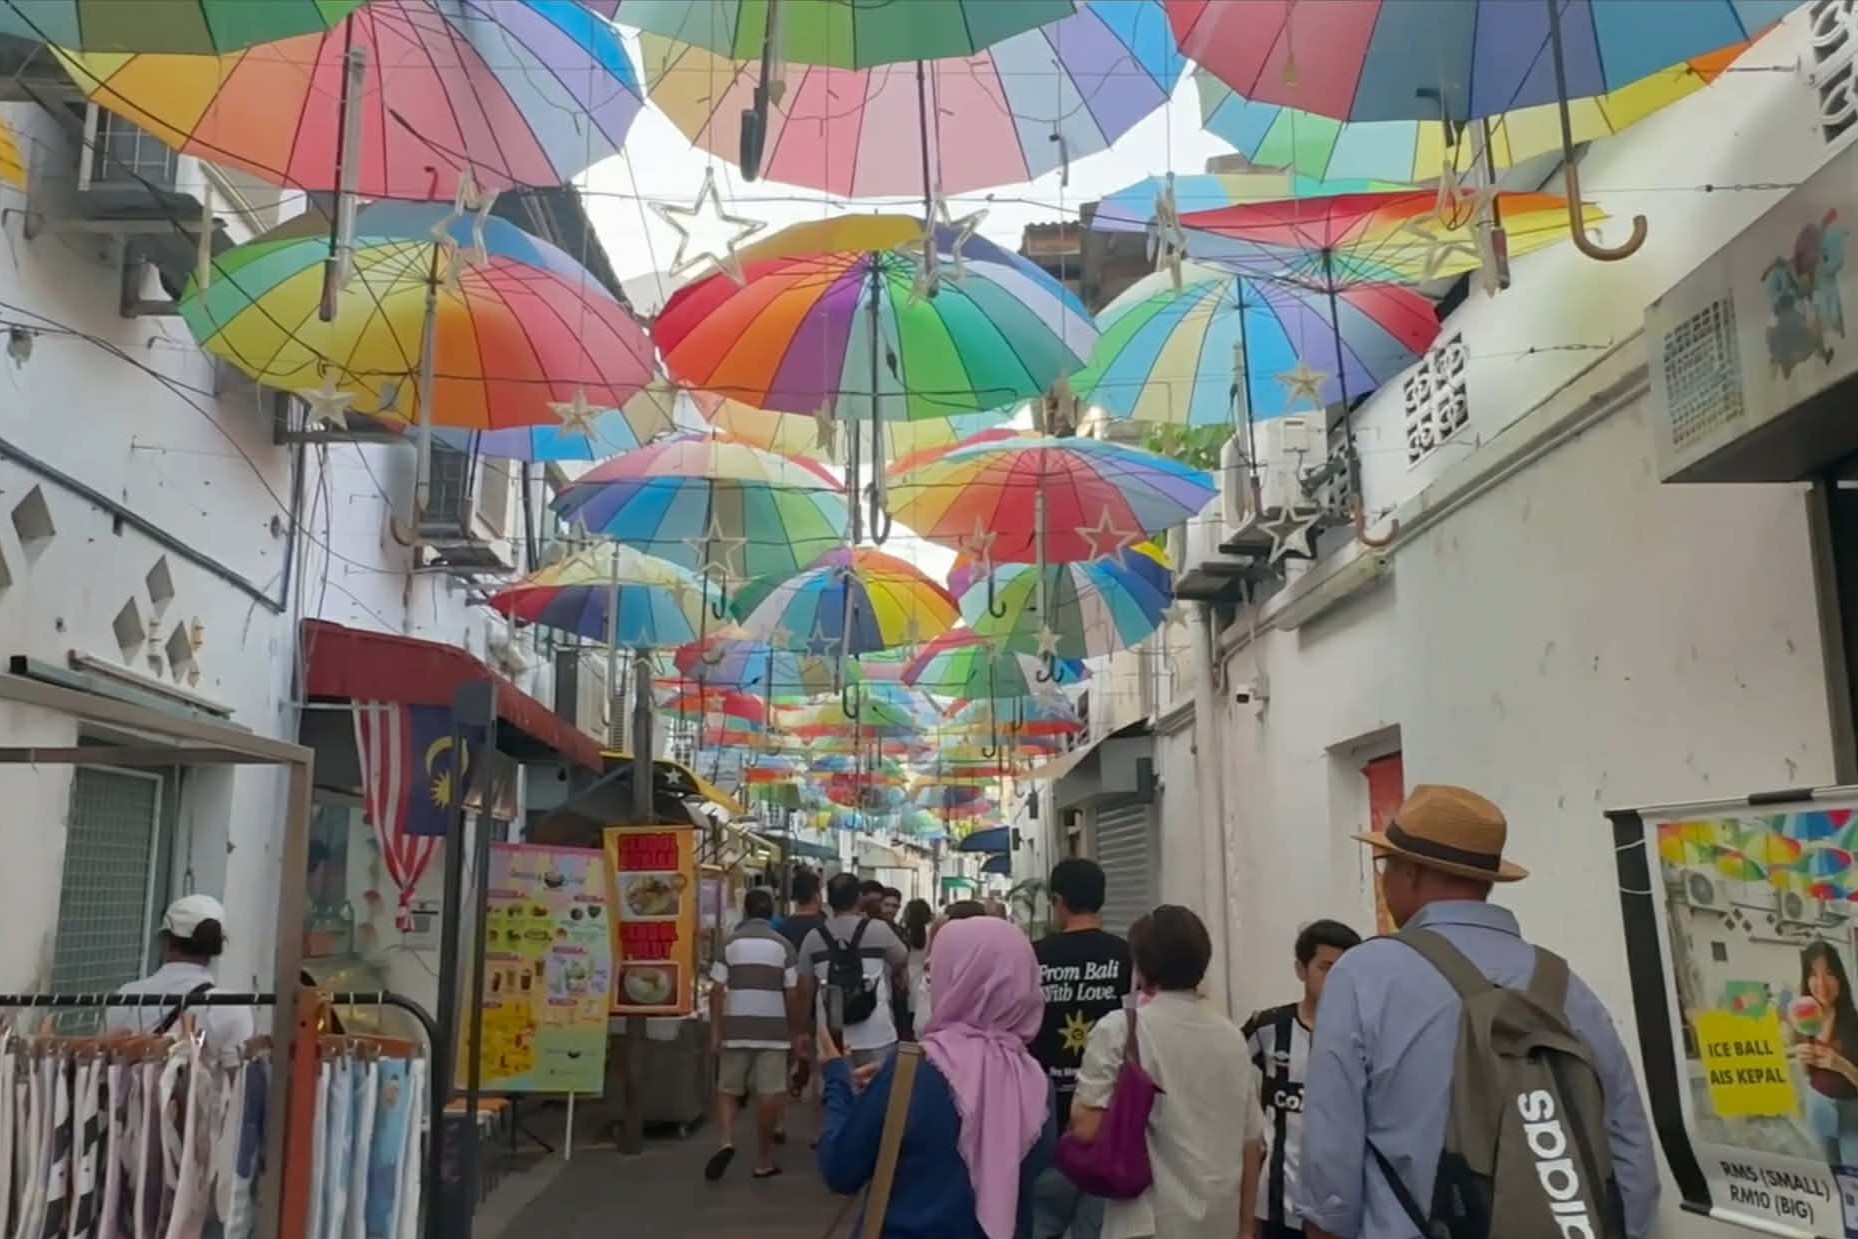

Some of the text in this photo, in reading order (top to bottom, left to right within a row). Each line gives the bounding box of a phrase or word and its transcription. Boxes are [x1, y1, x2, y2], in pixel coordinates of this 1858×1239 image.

[1038, 959, 1120, 982] From Bali
[1708, 1040, 1775, 1058] ICE BALL
[1710, 1067, 1786, 1086] AIS KEPAL
[1720, 1161, 1759, 1182] RM5
[1760, 1167, 1830, 1203] (SMALL)
[1730, 1183, 1771, 1209] RM10
[1775, 1194, 1814, 1225] (BIG)
